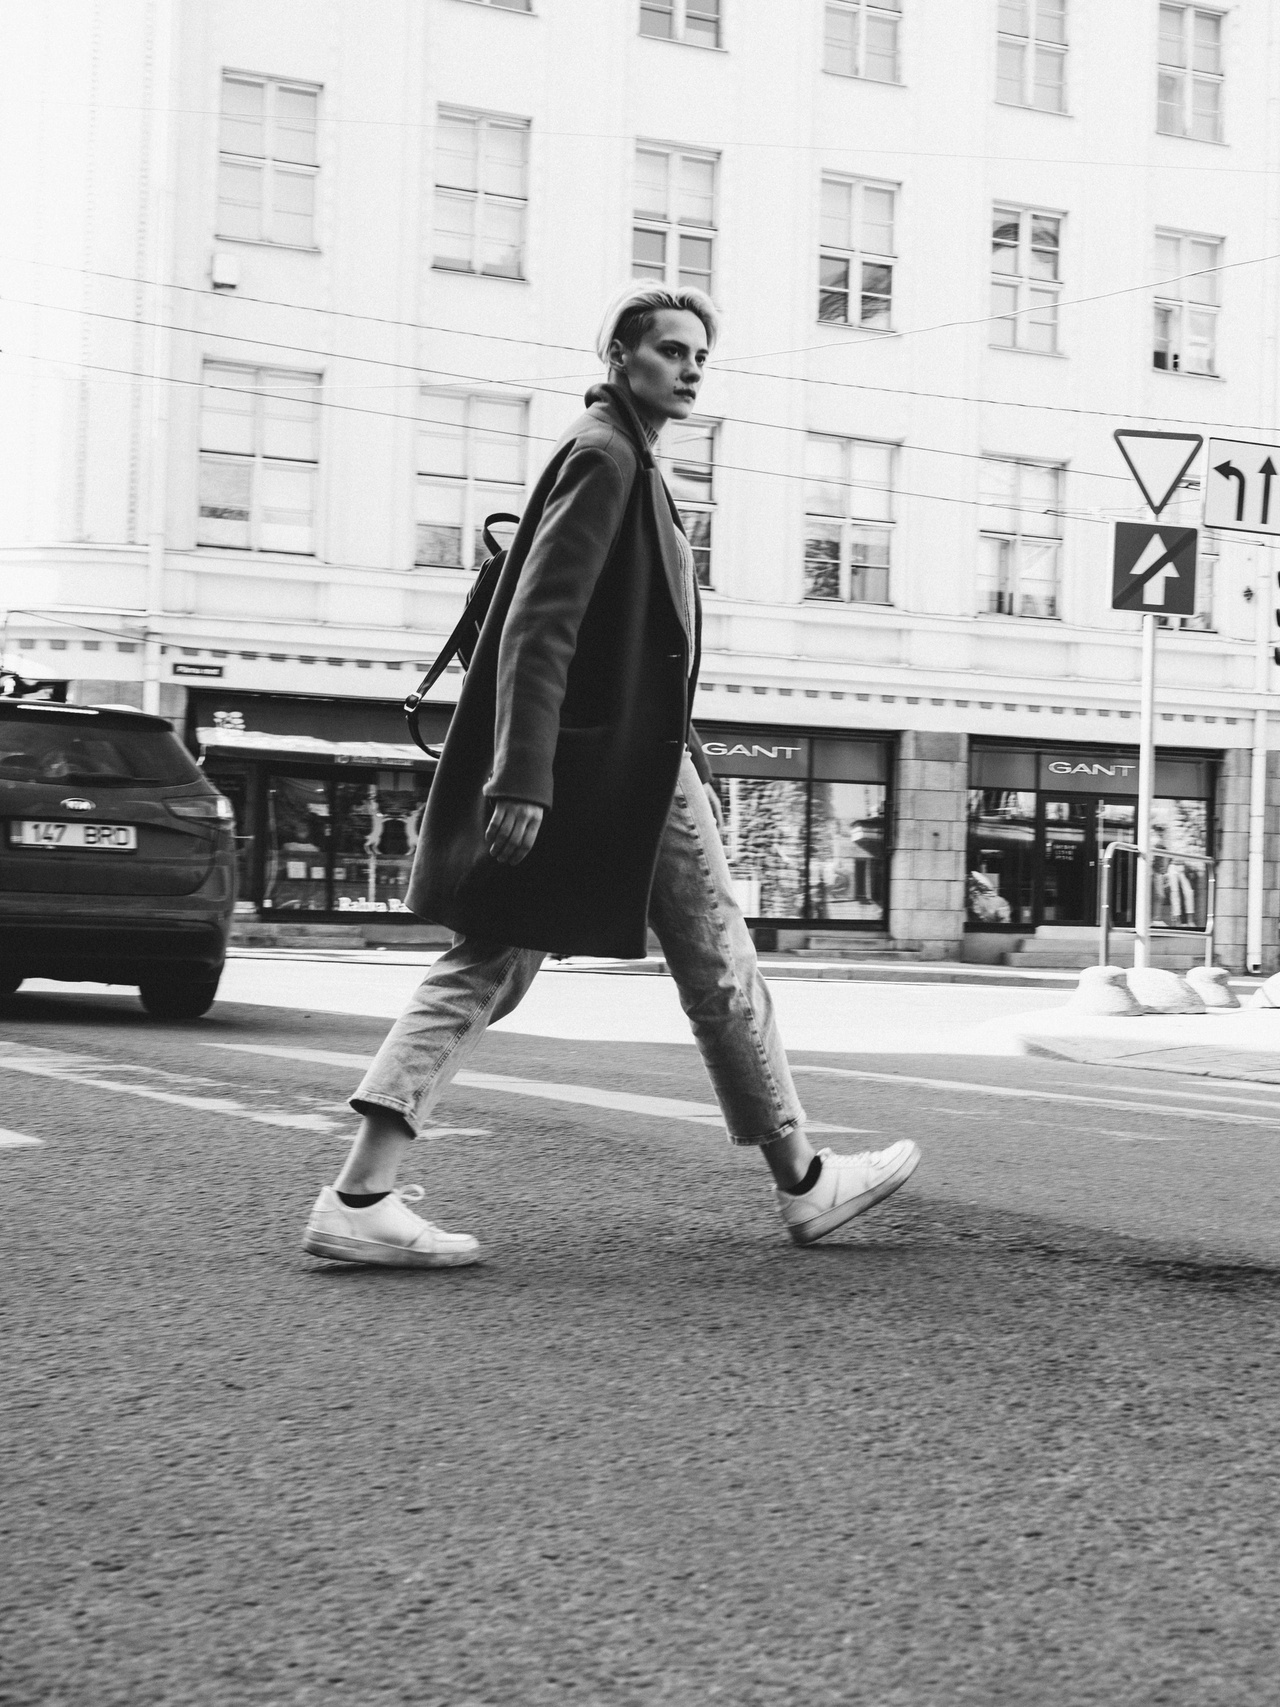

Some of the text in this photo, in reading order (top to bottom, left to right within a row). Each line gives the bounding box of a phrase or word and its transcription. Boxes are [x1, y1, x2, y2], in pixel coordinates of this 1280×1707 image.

[701, 742, 802, 759] GANT
[1048, 761, 1136, 777] GANT
[33, 824, 67, 843] 147
